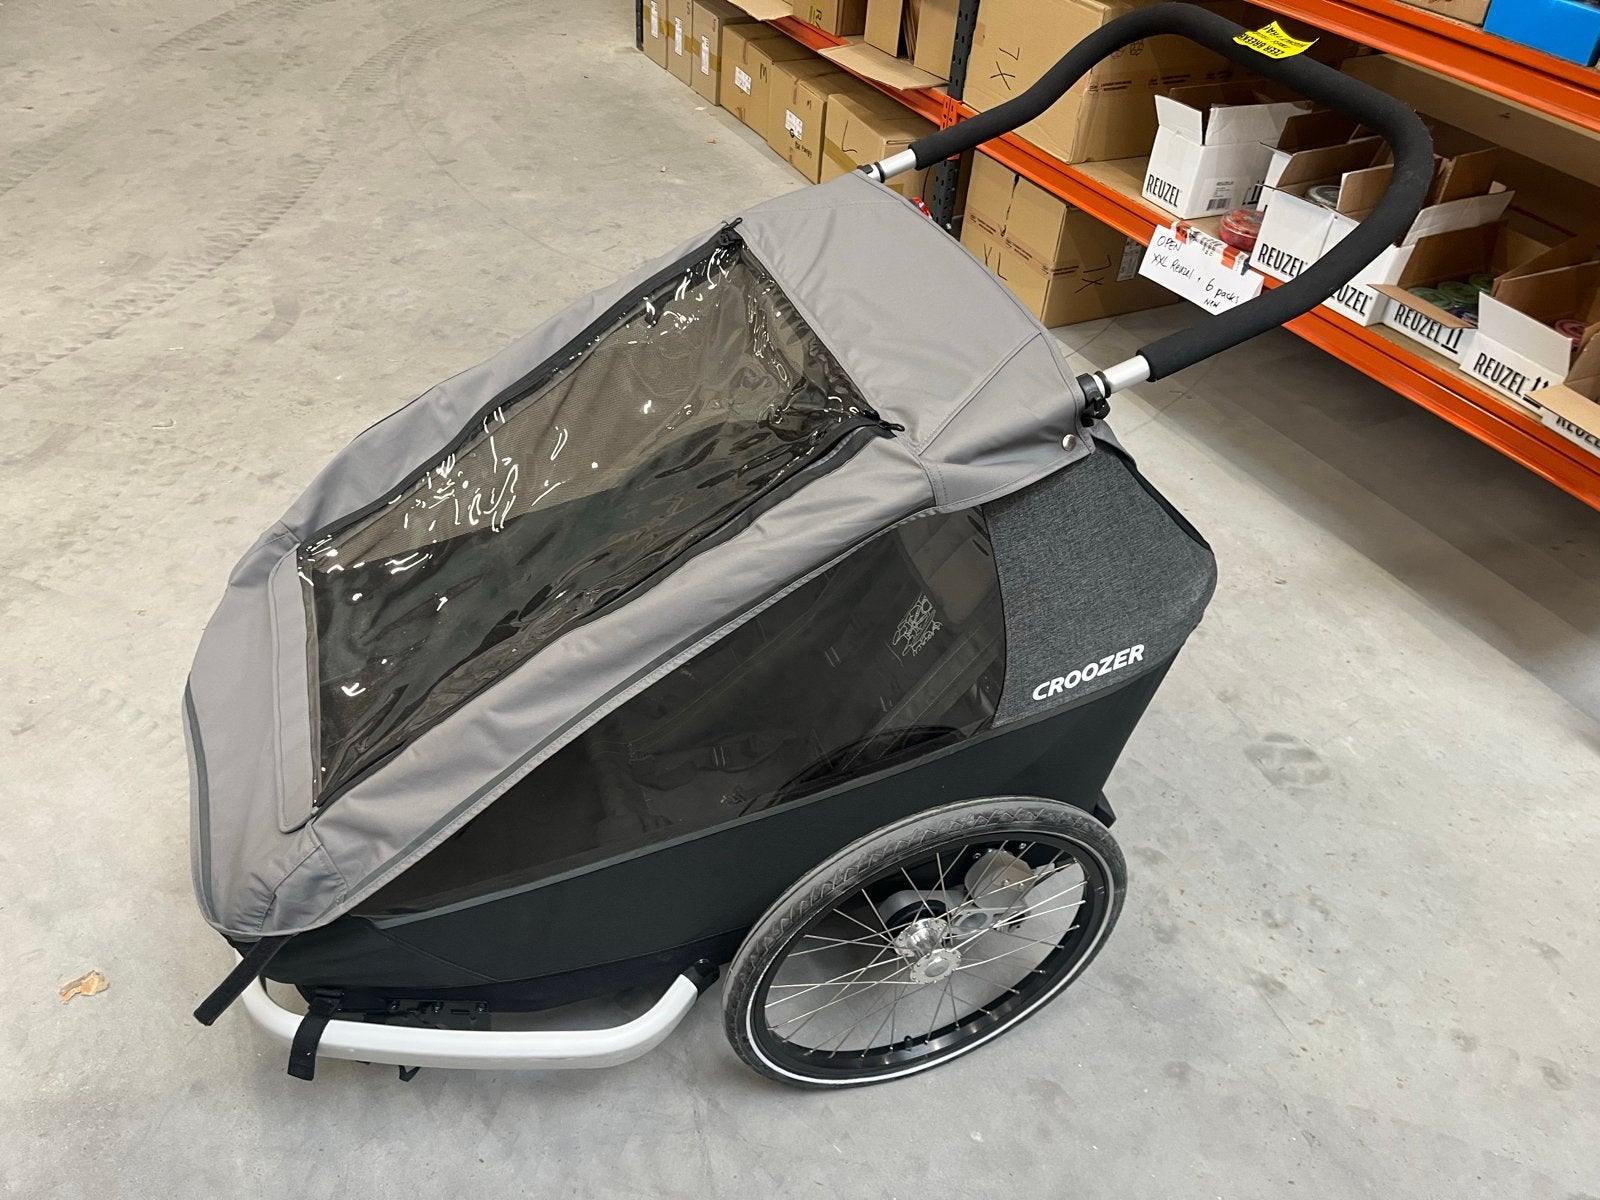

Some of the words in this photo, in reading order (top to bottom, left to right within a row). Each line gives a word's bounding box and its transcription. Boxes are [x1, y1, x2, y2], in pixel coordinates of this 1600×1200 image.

[1145, 174, 1181, 208] REUZEL
[1156, 235, 1181, 252] OPEN
[1151, 252, 1167, 269] XXL
[1205, 277, 1216, 292] 6
[1214, 288, 1240, 304] packs
[1330, 284, 1371, 317] UZEL
[1393, 303, 1442, 344] REUZEL
[1472, 352, 1525, 397] REUZEL
[1032, 644, 1145, 700] CROOZER
